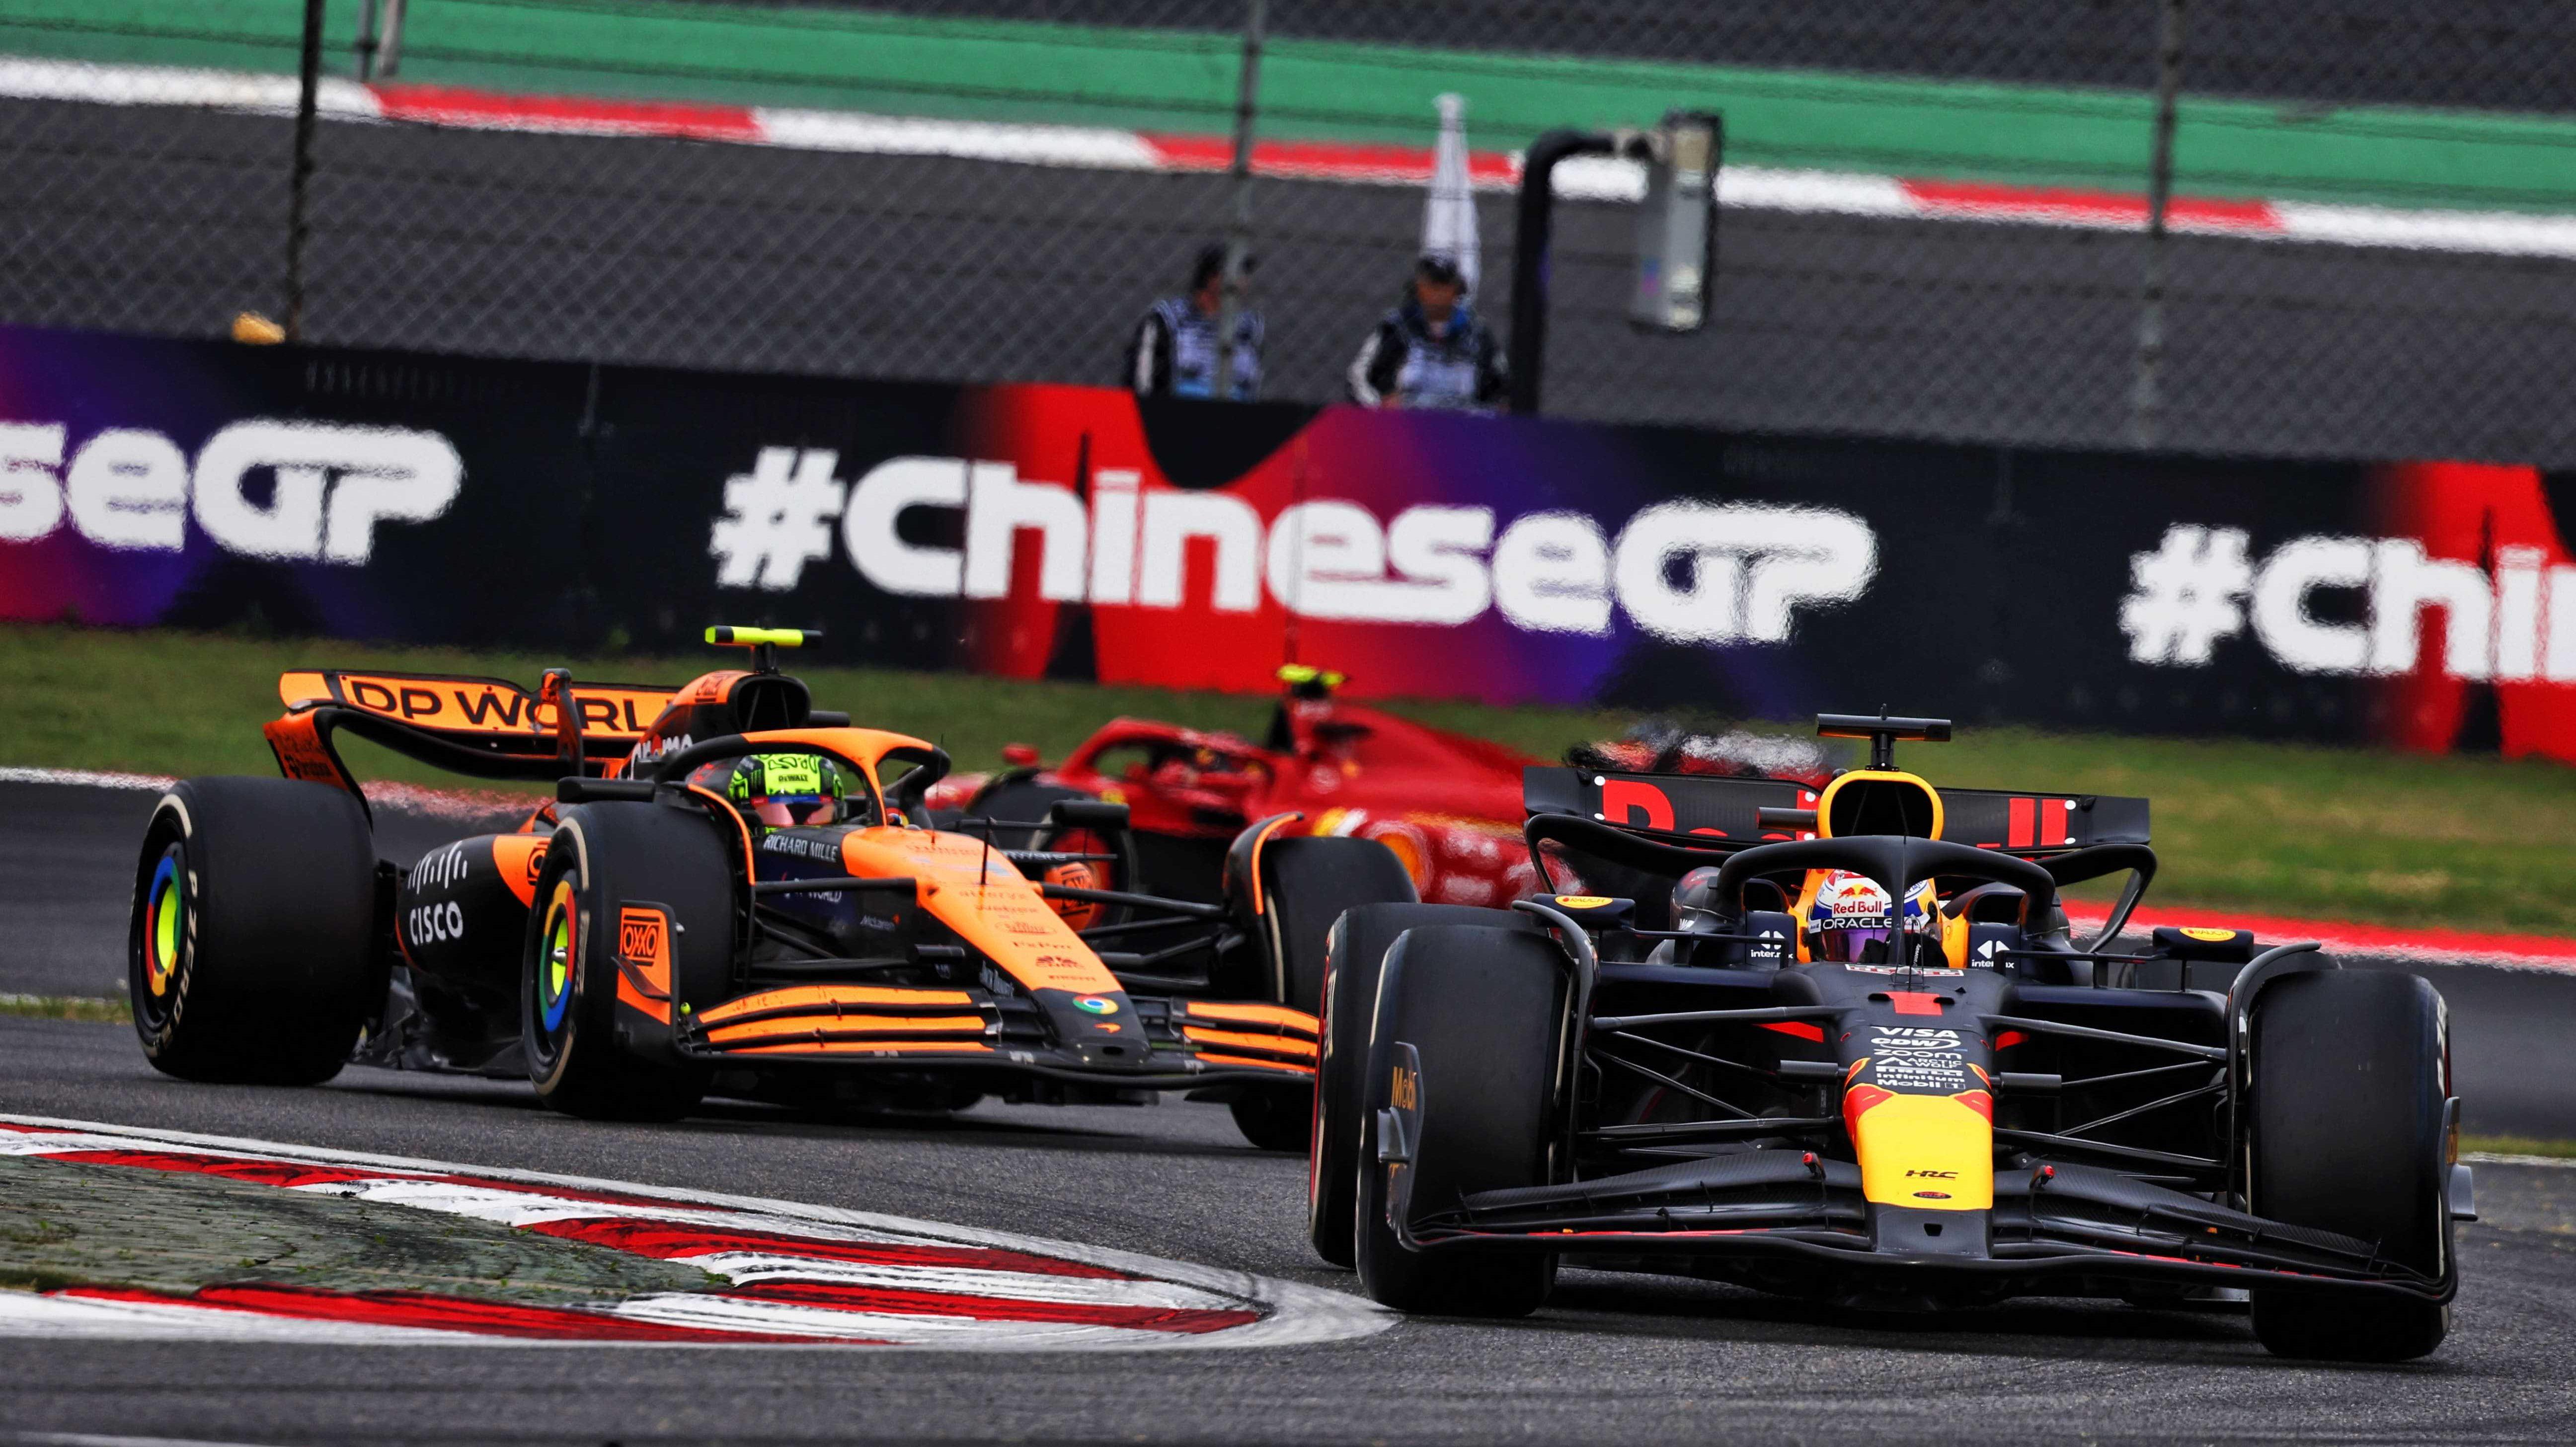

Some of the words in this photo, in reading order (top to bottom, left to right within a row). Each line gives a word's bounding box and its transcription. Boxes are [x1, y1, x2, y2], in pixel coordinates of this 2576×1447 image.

[708, 445, 1878, 647] #ChineseGP
[2118, 522, 2576, 684] #Chi
[351, 681, 442, 725] DP
[456, 690, 673, 732] WORL
[763, 834, 808, 855] RICHARD
[809, 841, 839, 863] MILLE
[1833, 901, 1856, 914] Red
[1858, 901, 1881, 913] Bull
[1822, 917, 1892, 929] ORACLE
[1871, 1026, 1959, 1039] VISA
[1873, 1048, 1962, 1060] zoom
[1875, 1065, 1964, 1077] PIRELLI
[1877, 1079, 1941, 1088] Mobil
[1905, 1170, 1959, 1179] HRC
